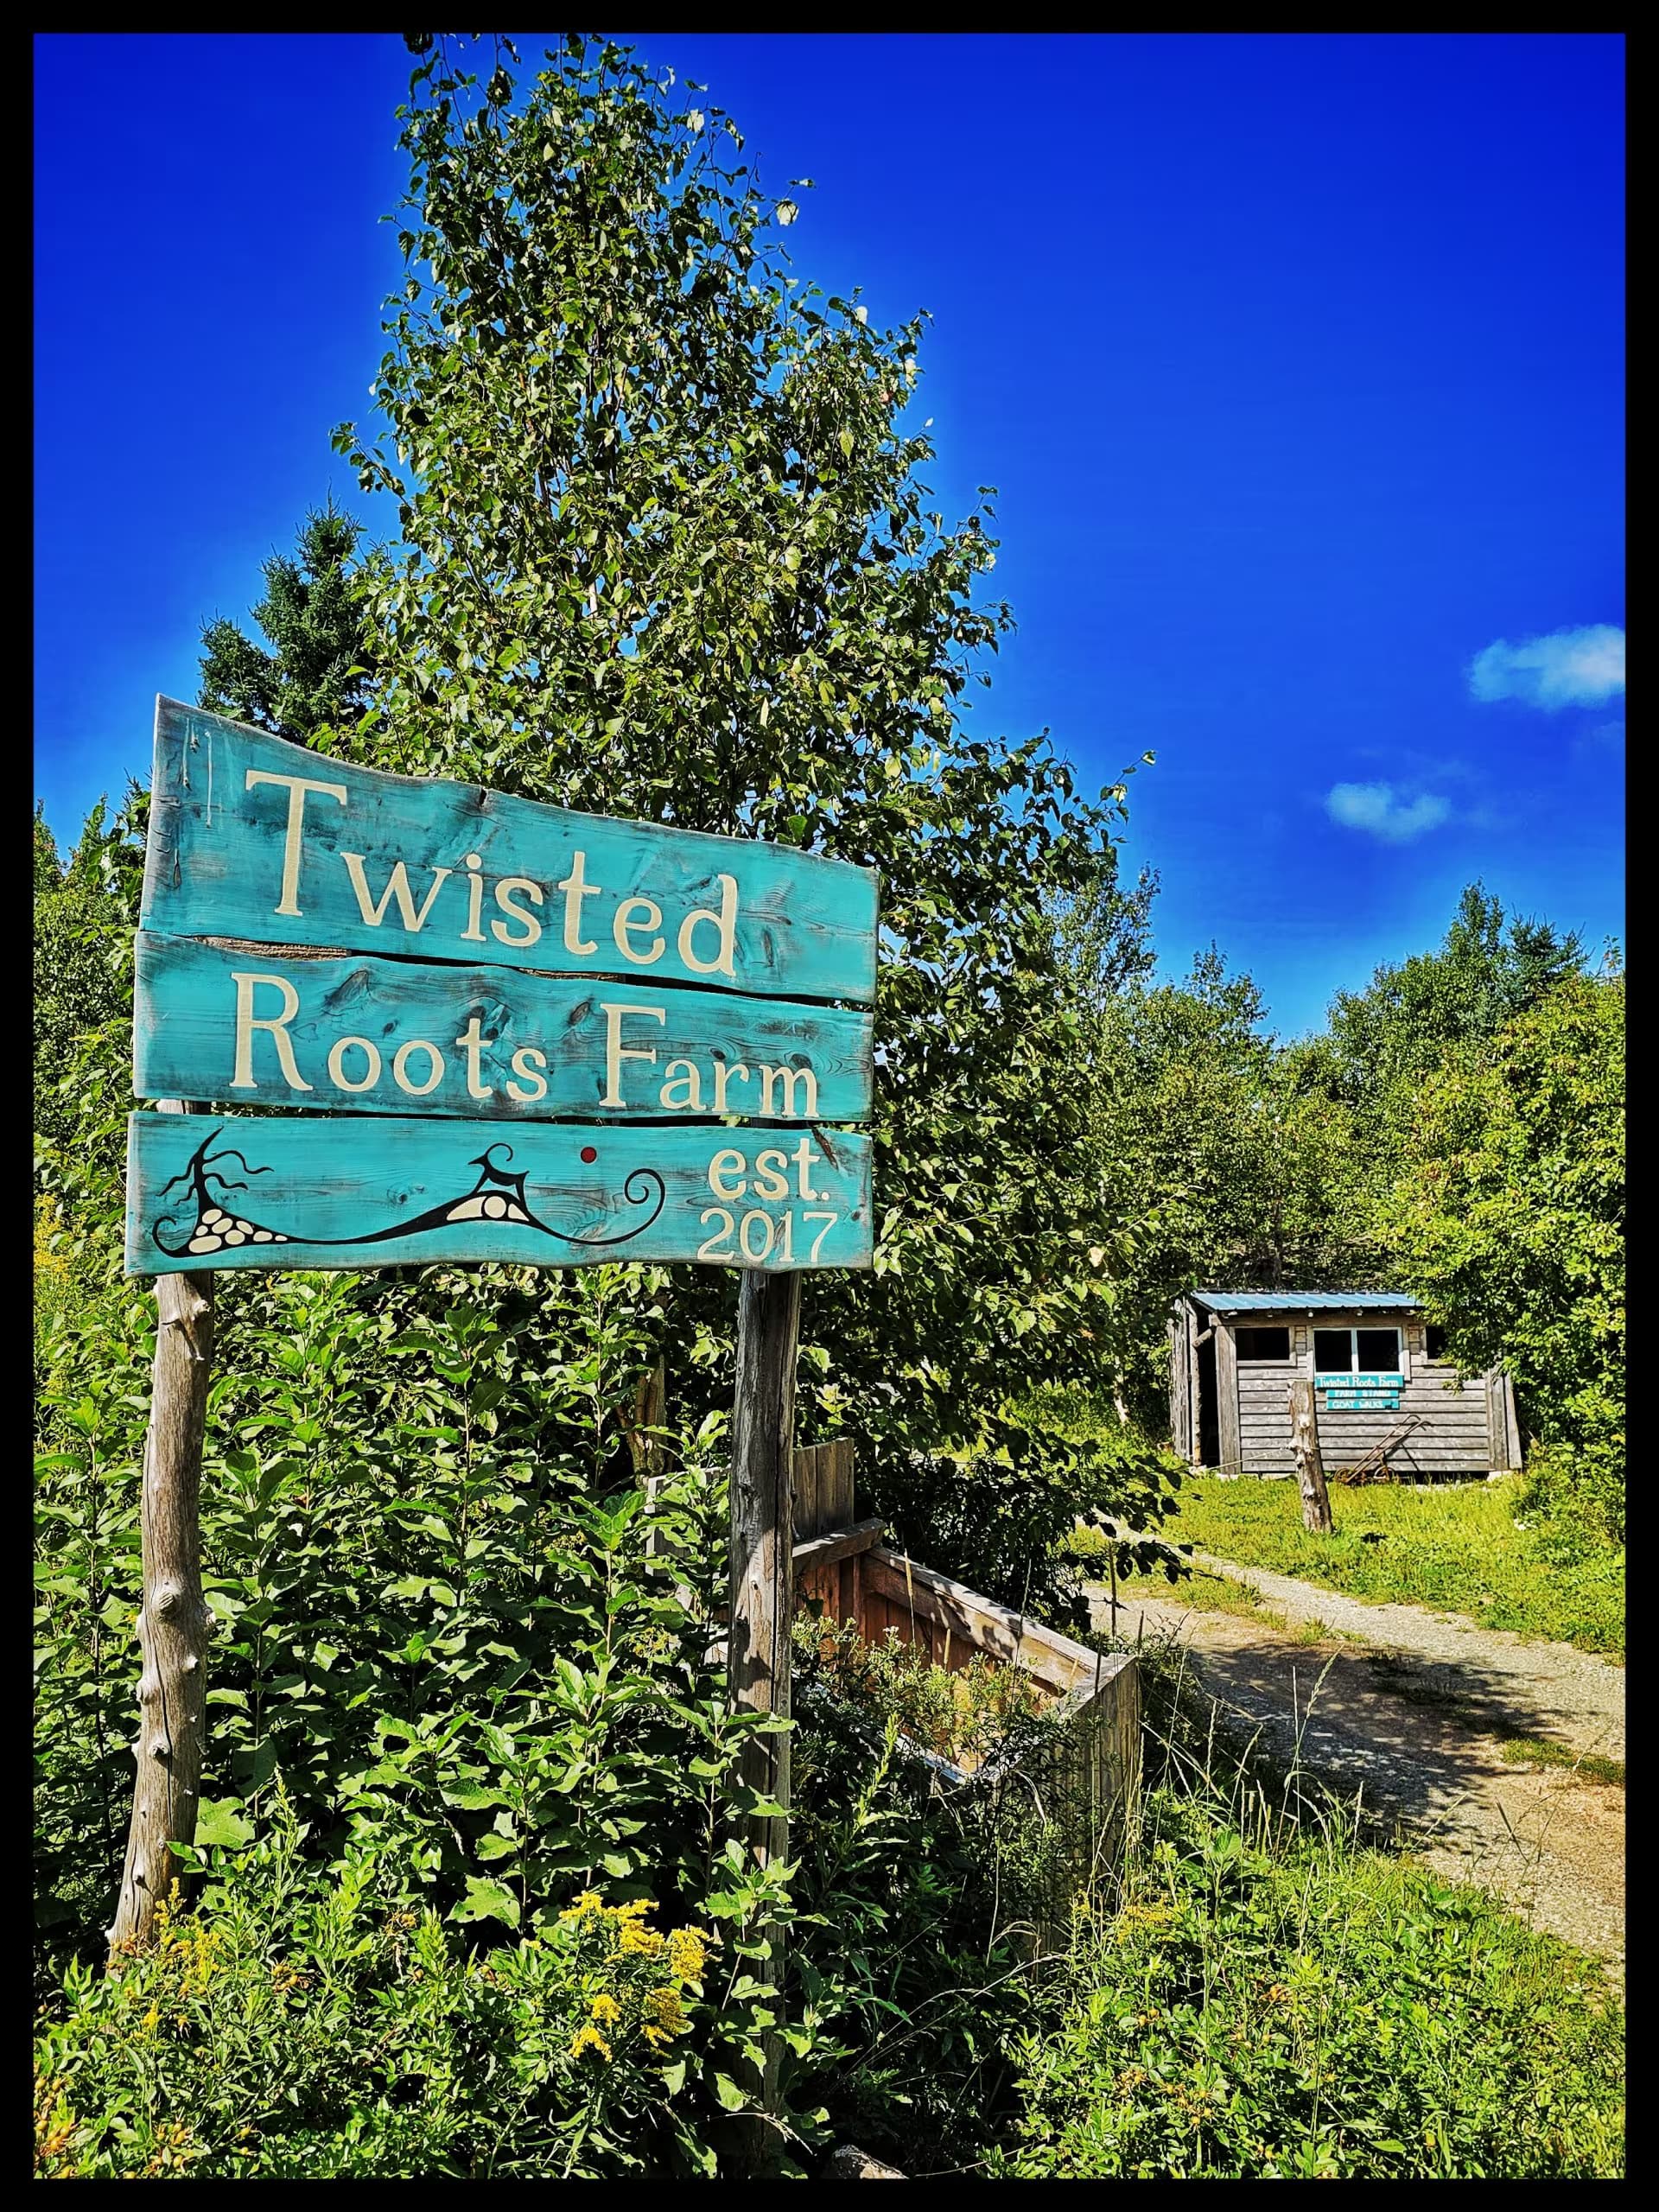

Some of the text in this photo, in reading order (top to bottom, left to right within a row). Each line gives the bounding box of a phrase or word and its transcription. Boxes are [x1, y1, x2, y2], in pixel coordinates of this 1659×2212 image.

[245, 769, 740, 978] Twisted
[229, 972, 820, 1117] Roots Farm
[707, 1137, 830, 1202] est.
[696, 1208, 838, 1263] 2017
[1317, 1376, 1398, 1388] Twisted Roots Farm
[1332, 1401, 1354, 1409] GOAT
